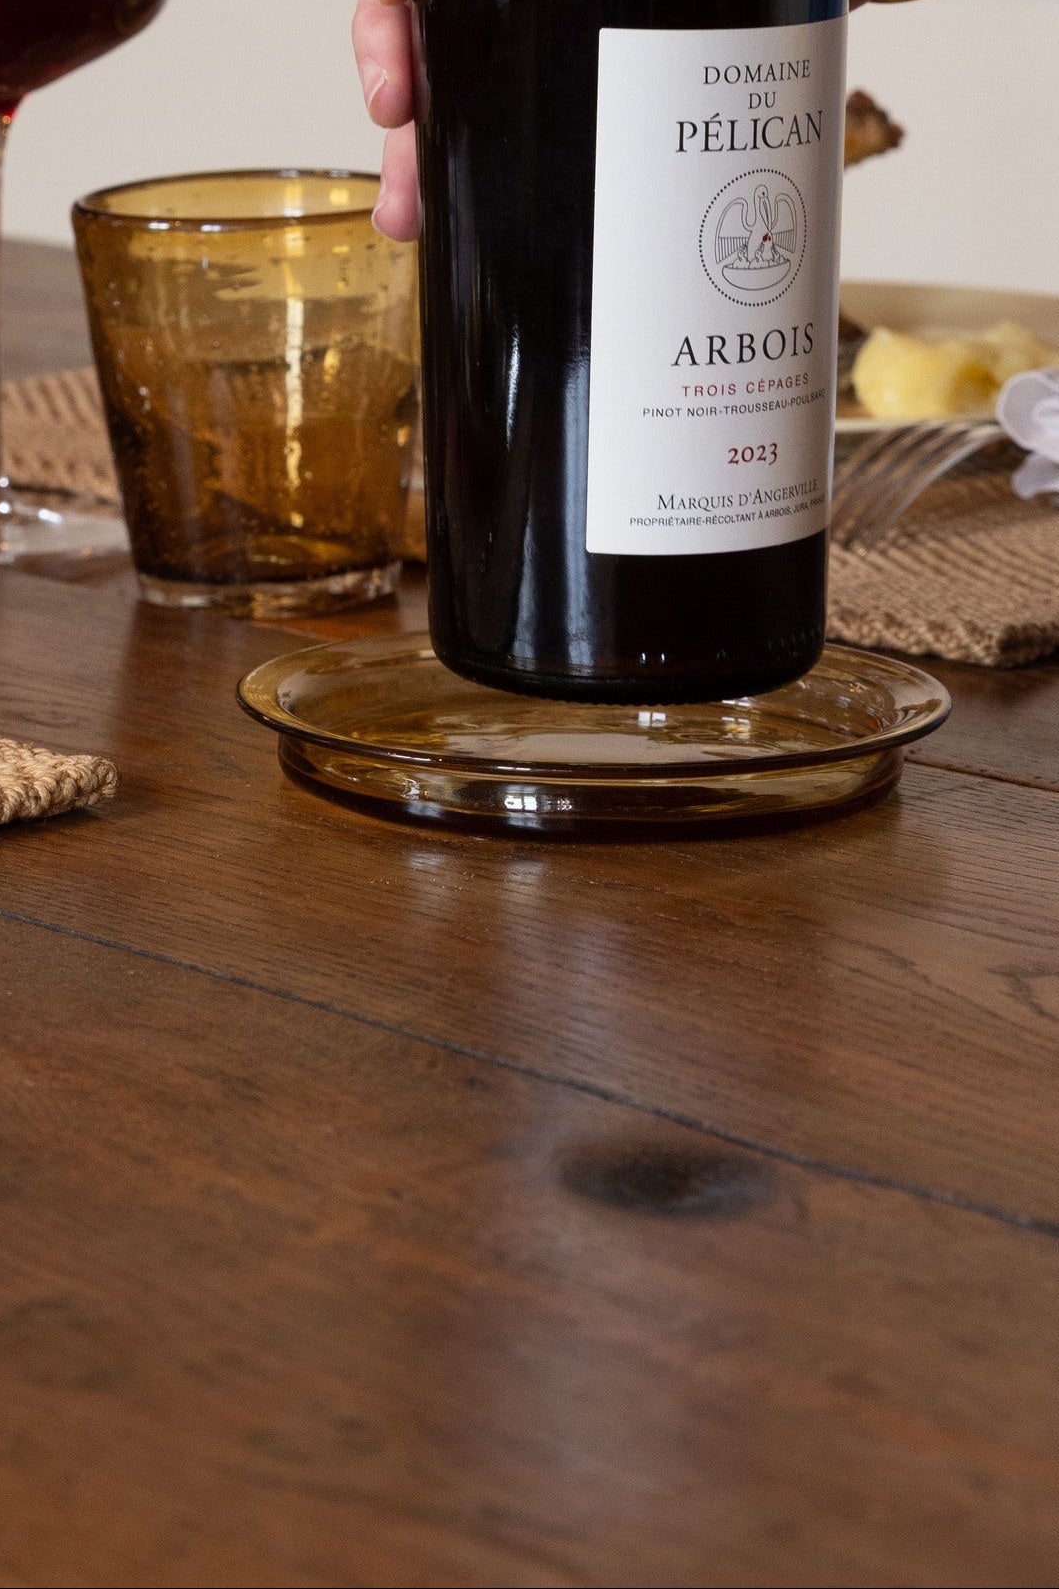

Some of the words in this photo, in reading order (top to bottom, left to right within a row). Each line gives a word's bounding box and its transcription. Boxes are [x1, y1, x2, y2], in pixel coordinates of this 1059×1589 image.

[703, 59, 810, 85] DOMAINE
[748, 91, 776, 109] DU
[675, 110, 823, 153] PÉLICAN
[671, 322, 814, 367] ARBOIS
[682, 383, 736, 397] TROIS
[746, 373, 809, 394] CÉPAGES
[642, 408, 682, 418] PINOT
[727, 442, 778, 465] 2023
